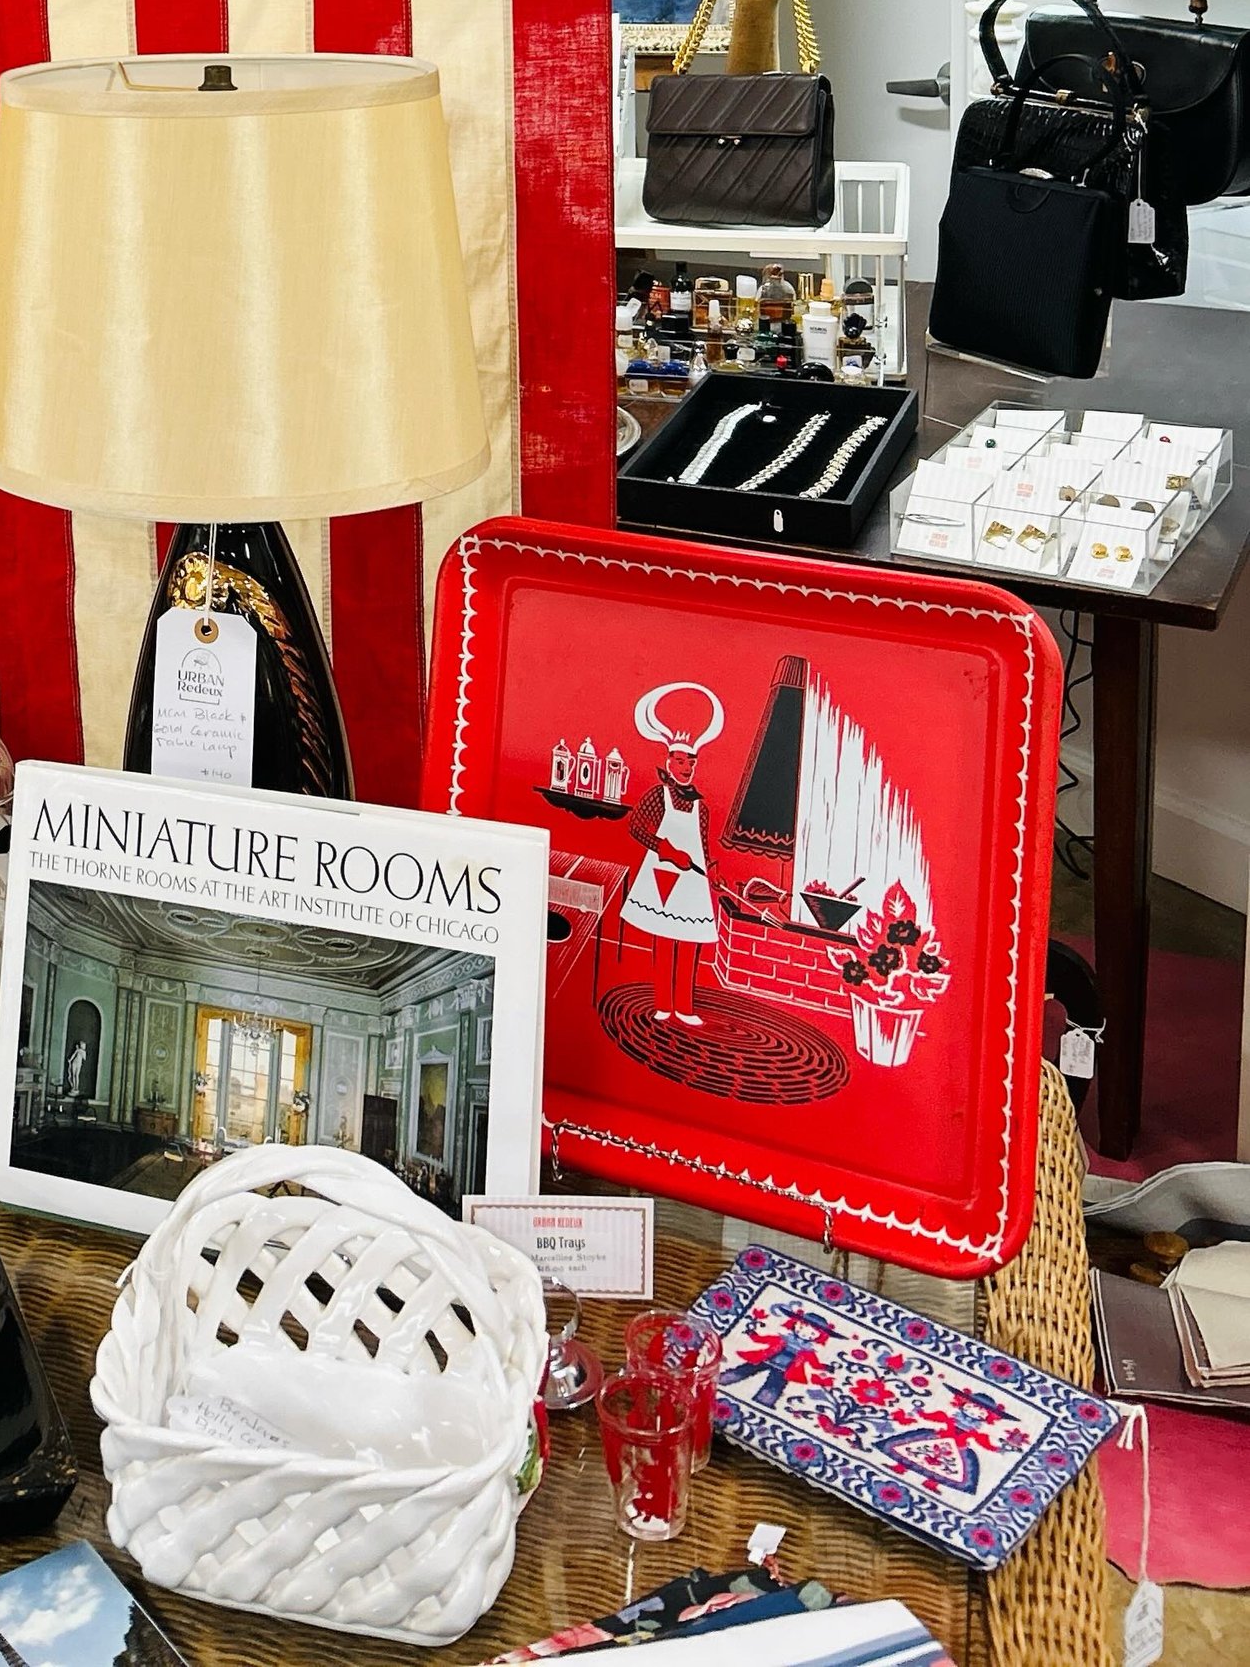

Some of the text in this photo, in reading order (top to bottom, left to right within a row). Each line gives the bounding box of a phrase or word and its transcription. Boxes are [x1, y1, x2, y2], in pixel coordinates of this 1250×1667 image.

[177, 670, 225, 687] URBAN
[177, 681, 223, 697] Redeux
[195, 707, 235, 722] Black
[153, 723, 246, 740] Gold Ceramic
[30, 798, 502, 914] MINIATURE ROOMS
[29, 851, 499, 944] THE THORNE ROOMS AT THE ART INSTITUTE OF CHICAGO
[536, 1236, 586, 1252] BBQ Trays
